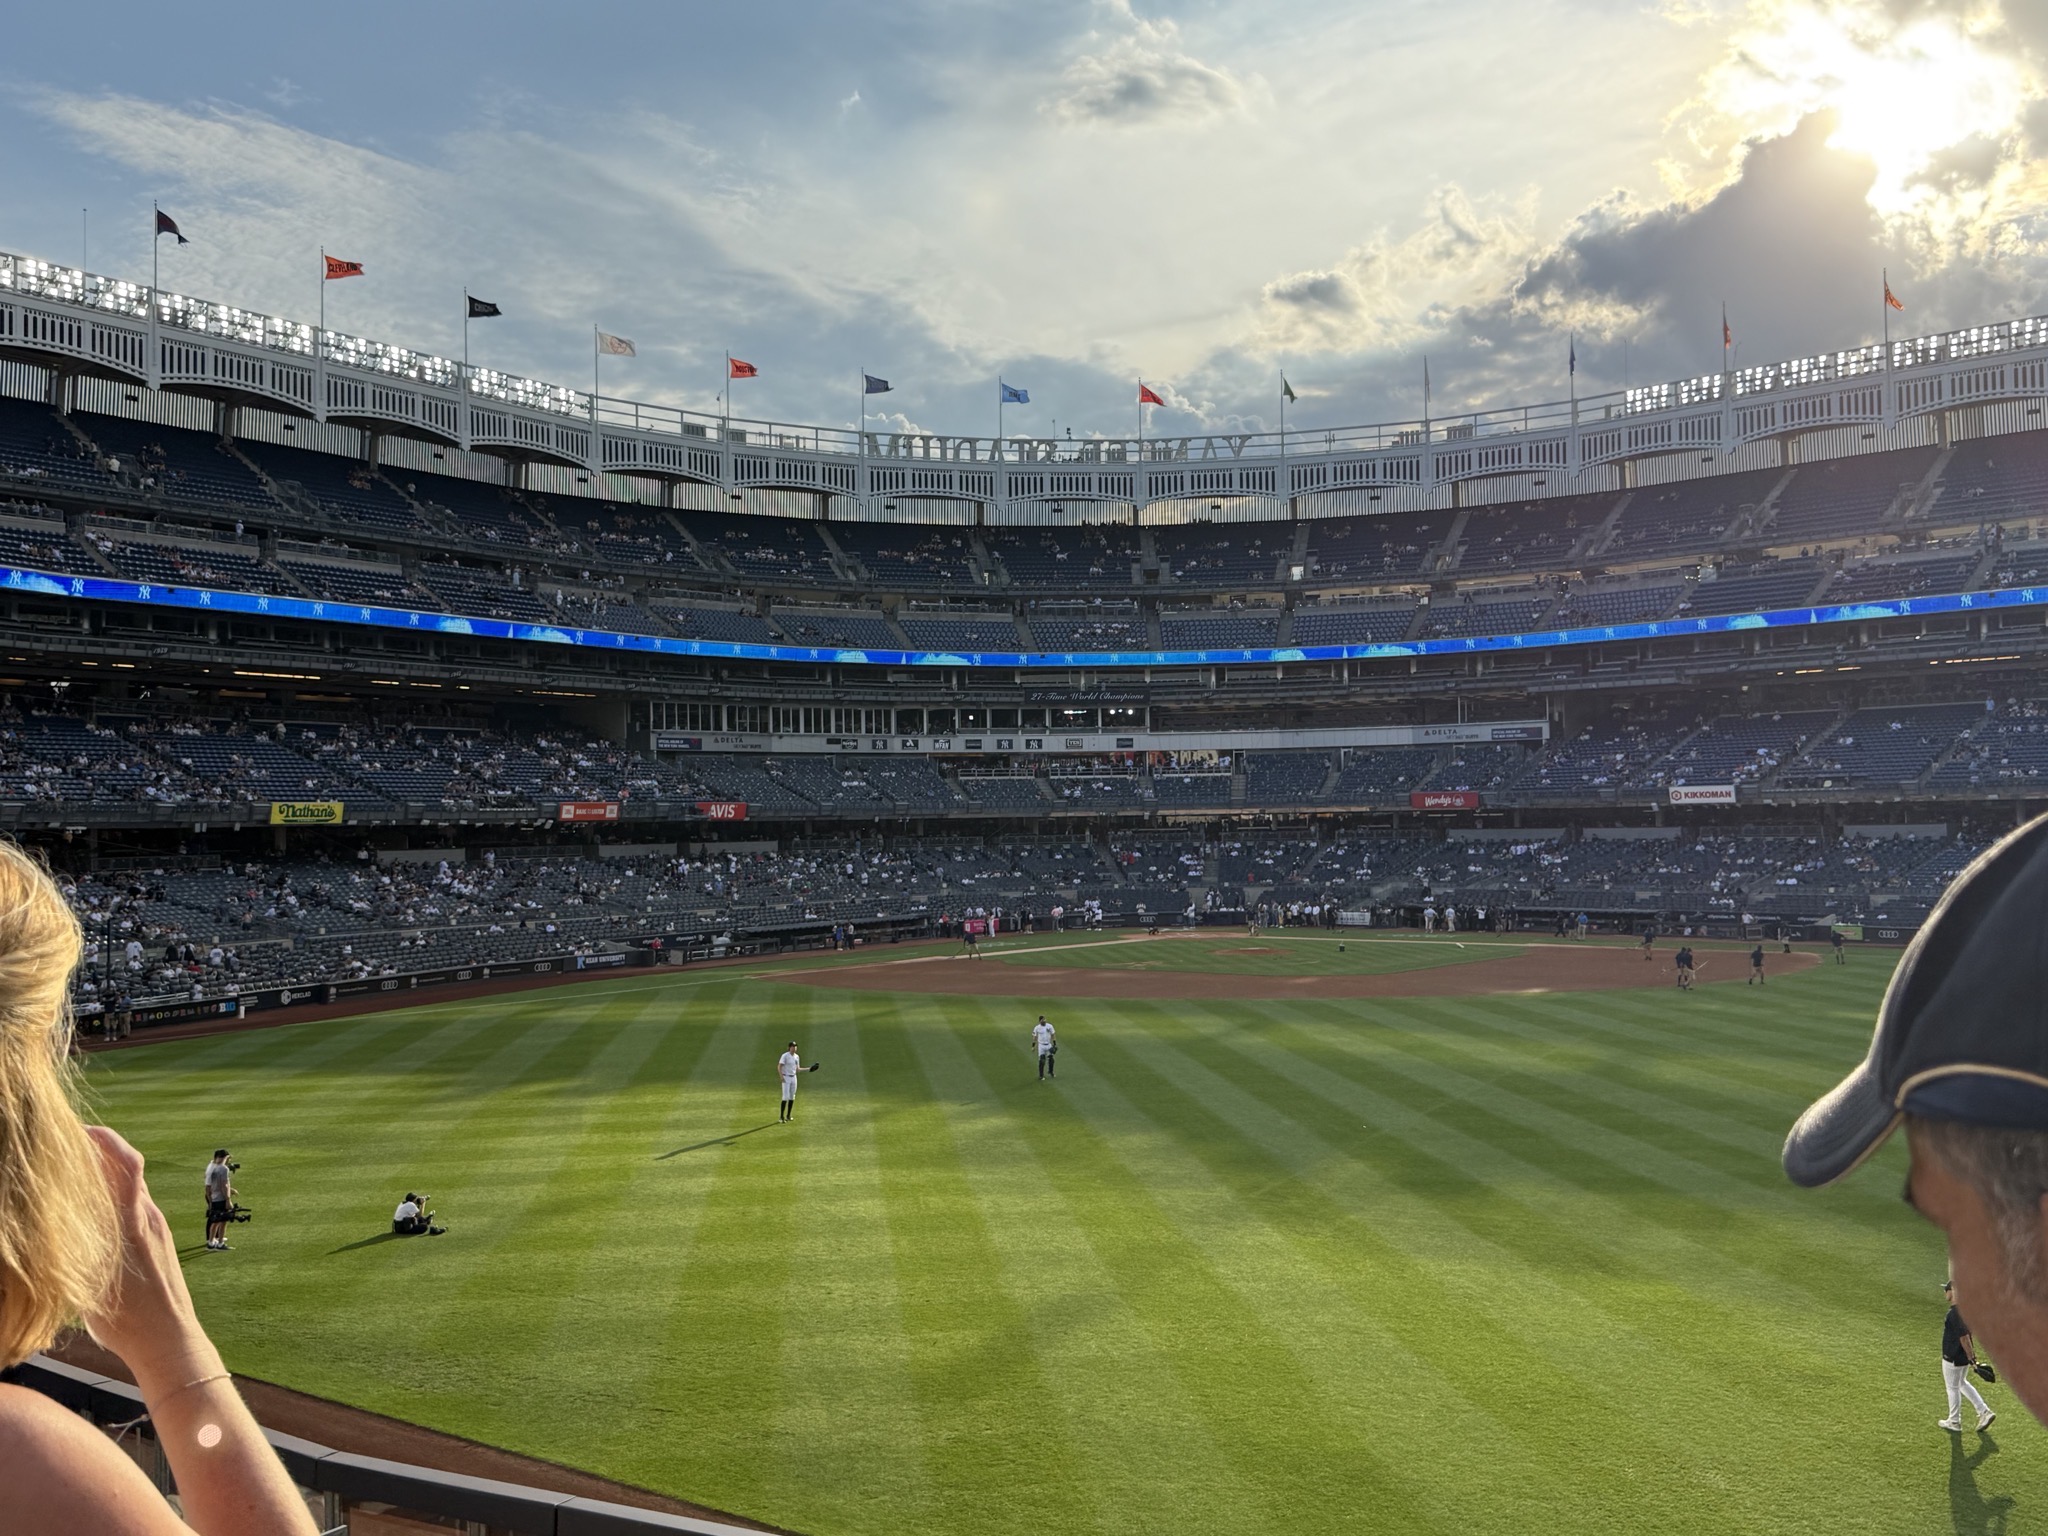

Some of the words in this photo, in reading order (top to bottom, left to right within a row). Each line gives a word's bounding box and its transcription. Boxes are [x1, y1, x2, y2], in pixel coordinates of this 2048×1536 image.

[1030, 691, 1067, 702] 27-Time
[1070, 690, 1097, 702] World
[1099, 691, 1144, 704] Champions
[1424, 795, 1452, 808] Wendy's
[1684, 790, 1732, 800] KIKKOMAN
[278, 804, 337, 820] Nathan's
[710, 804, 736, 818] AVIS
